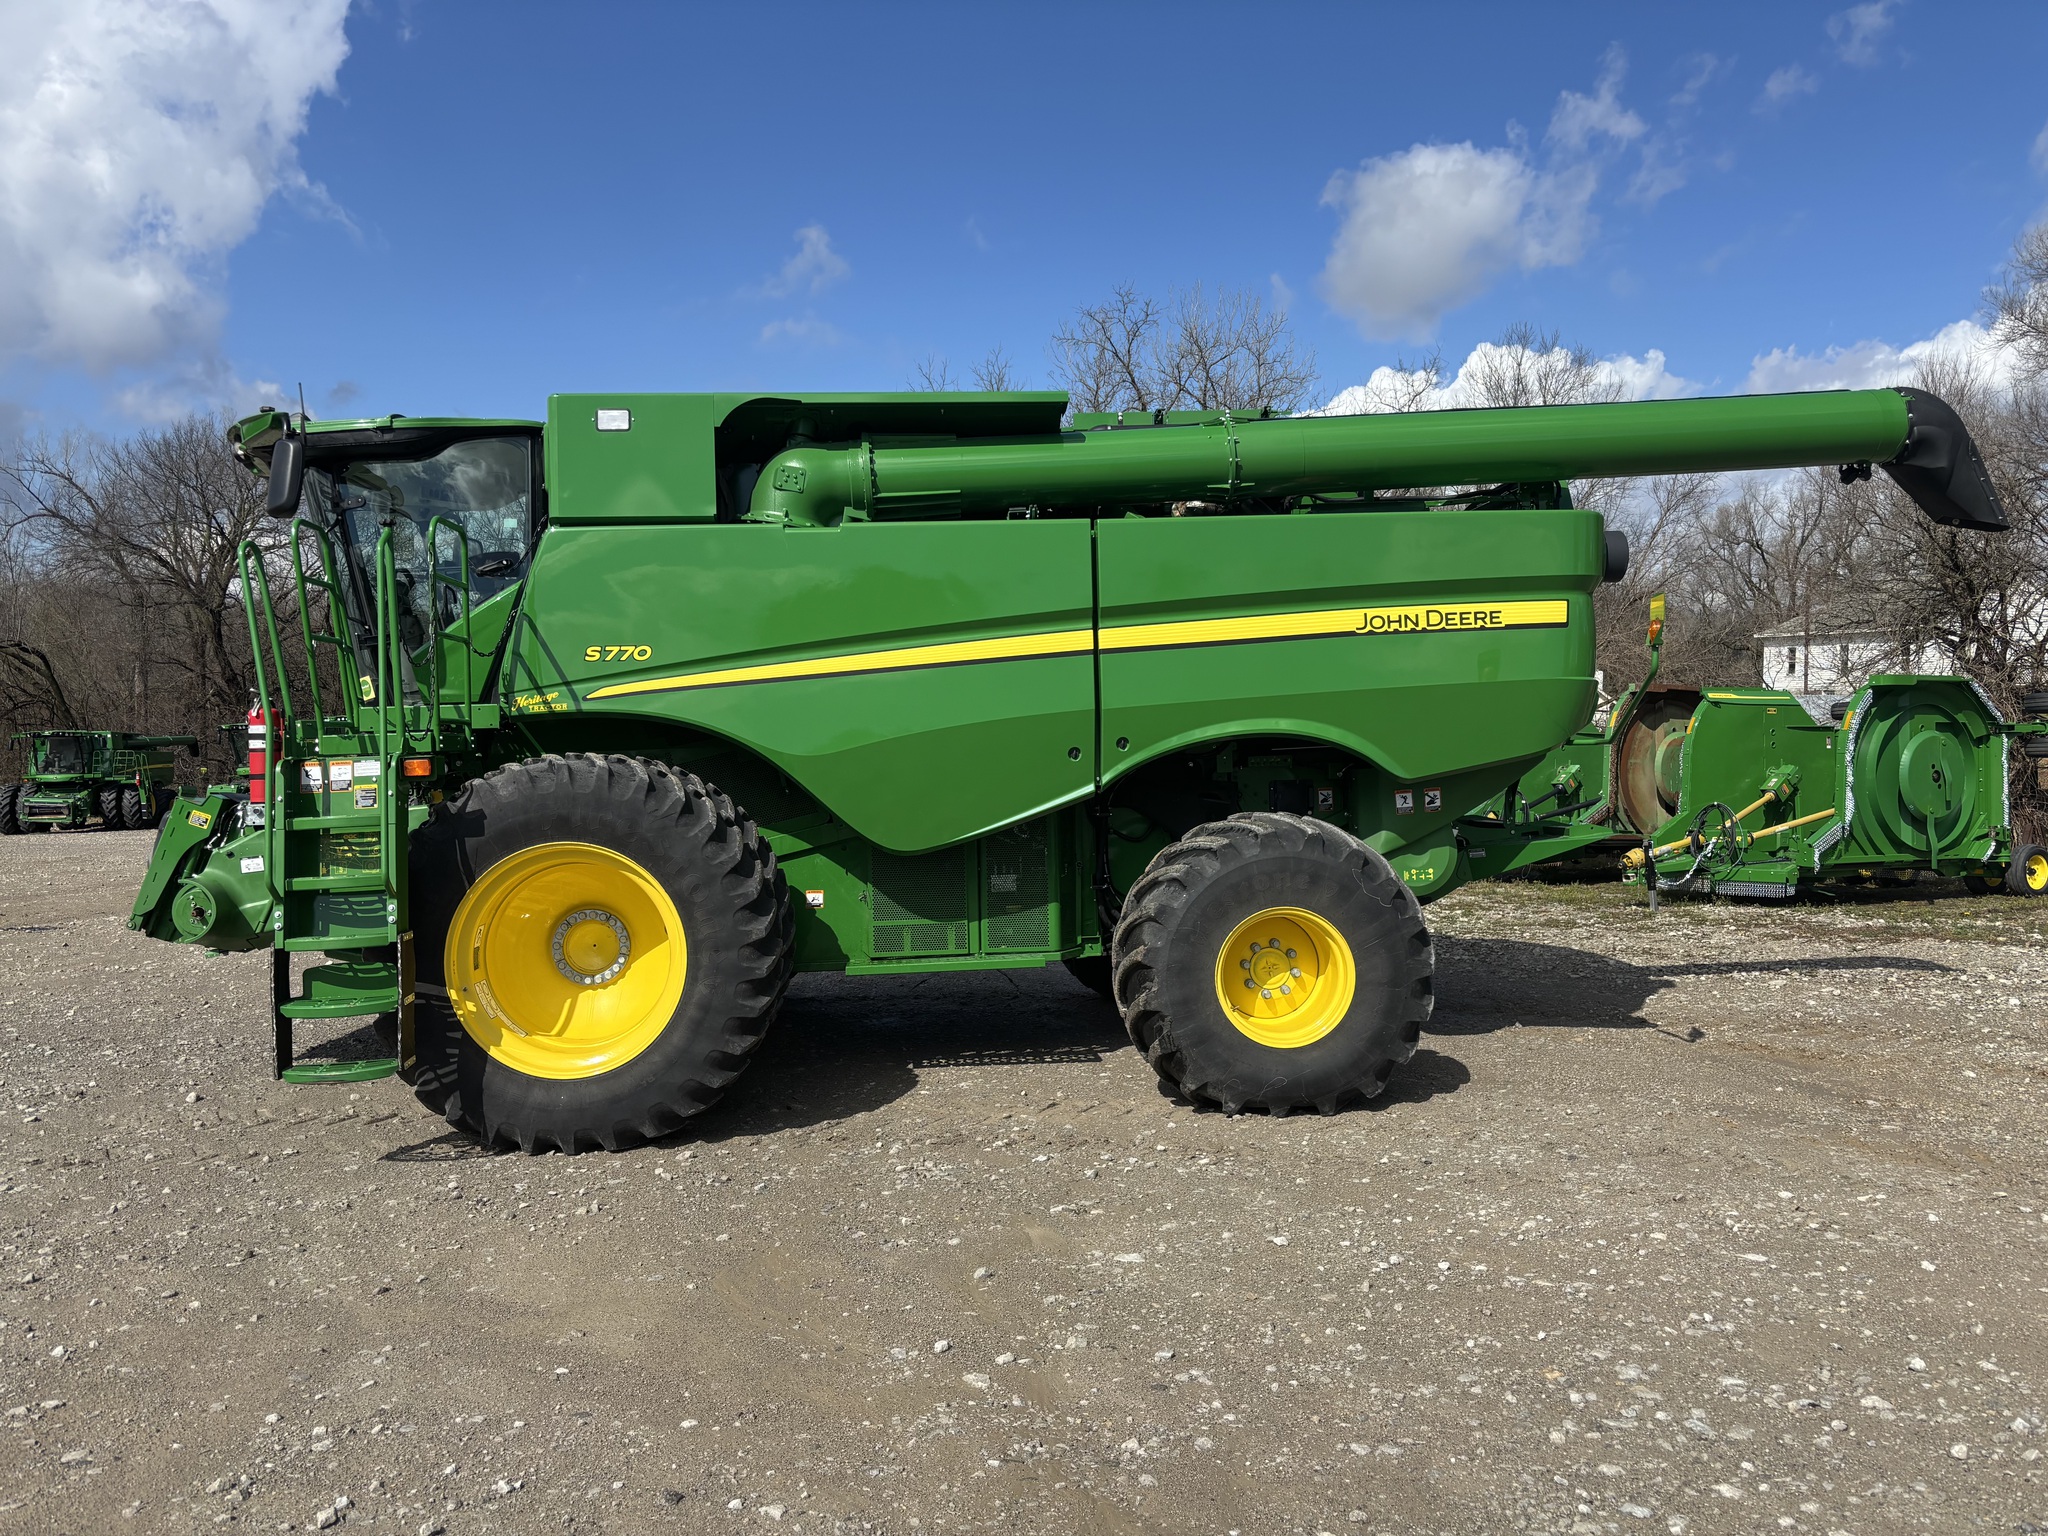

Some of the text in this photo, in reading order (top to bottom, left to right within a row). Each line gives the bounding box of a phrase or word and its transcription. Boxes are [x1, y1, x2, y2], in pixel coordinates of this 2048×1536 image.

[1355, 609, 1503, 631] JOHN DEERE
[584, 644, 653, 662] S770
[511, 692, 559, 711] Heritage
[528, 703, 568, 712] TRACTOR
